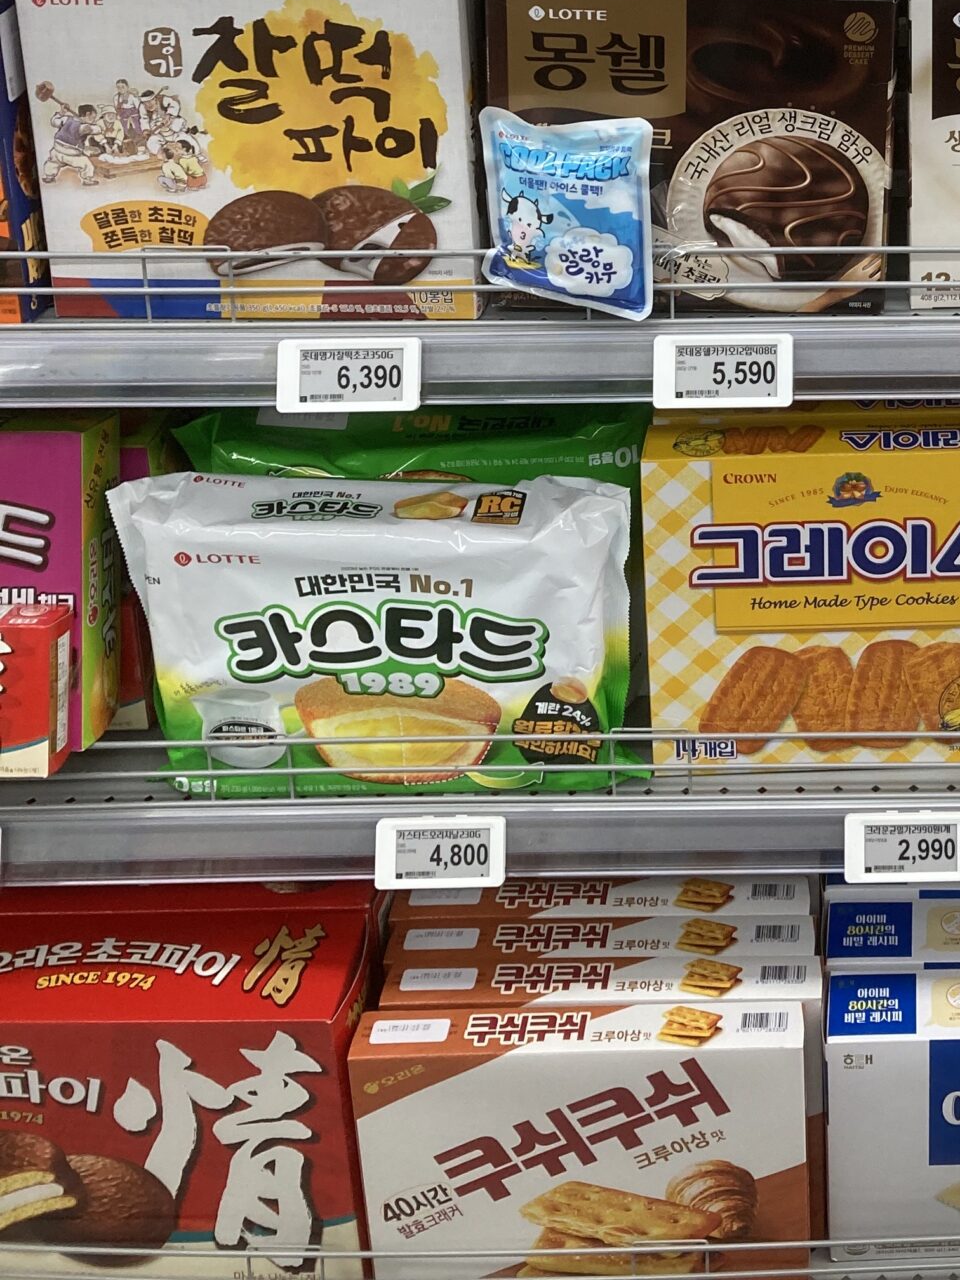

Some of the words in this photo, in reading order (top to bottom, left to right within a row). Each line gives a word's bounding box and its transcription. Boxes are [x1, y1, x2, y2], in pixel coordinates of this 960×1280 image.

[549, 8, 607, 20] LOTTE
[192, 16, 392, 124] 찰떡
[524, 32, 668, 96] 몽쉘
[283, 117, 438, 172] 파이
[685, 129, 735, 182] 국내산
[734, 111, 772, 138] 리얼
[778, 110, 838, 138] 생크림
[840, 129, 875, 167] 함유
[93, 206, 141, 226] 달콤한
[147, 205, 198, 225] 초코와
[102, 227, 152, 248] 쫀득한
[158, 225, 195, 246] 찰떡
[559, 246, 603, 276] 말랑
[585, 263, 617, 284] 카우
[337, 364, 402, 393] 6,390
[712, 360, 776, 388] 5,590
[723, 471, 777, 484] CROWN
[197, 553, 261, 565] LOTTE
[296, 574, 401, 596] 대한민국
[410, 575, 474, 597] No.1
[751, 596, 799, 610] Home
[803, 595, 851, 610] Made
[854, 594, 891, 611] Type
[895, 592, 959, 606] Cookies
[225, 608, 538, 670] 카스타드
[338, 672, 446, 697] 1989
[430, 843, 488, 868] 4,800
[898, 838, 956, 865] 2,990
[494, 924, 610, 951] 쿠쉬쿠쉬
[613, 939, 661, 950] 크루아상
[661, 940, 671, 949] 맛
[36, 972, 100, 990] SINCE
[103, 971, 156, 991] 1974
[857, 988, 890, 998] 아이비
[844, 1012, 867, 1023] 비밀
[870, 1011, 903, 1023] 레시피
[848, 999, 899, 1011] 80시간의
[433, 1056, 731, 1202] 쿠쉬쿠쉬
[113, 1030, 324, 1269] 情
[633, 1131, 710, 1170] 크루아상
[710, 1129, 727, 1144] 맛
[381, 1183, 454, 1223] 40시간
